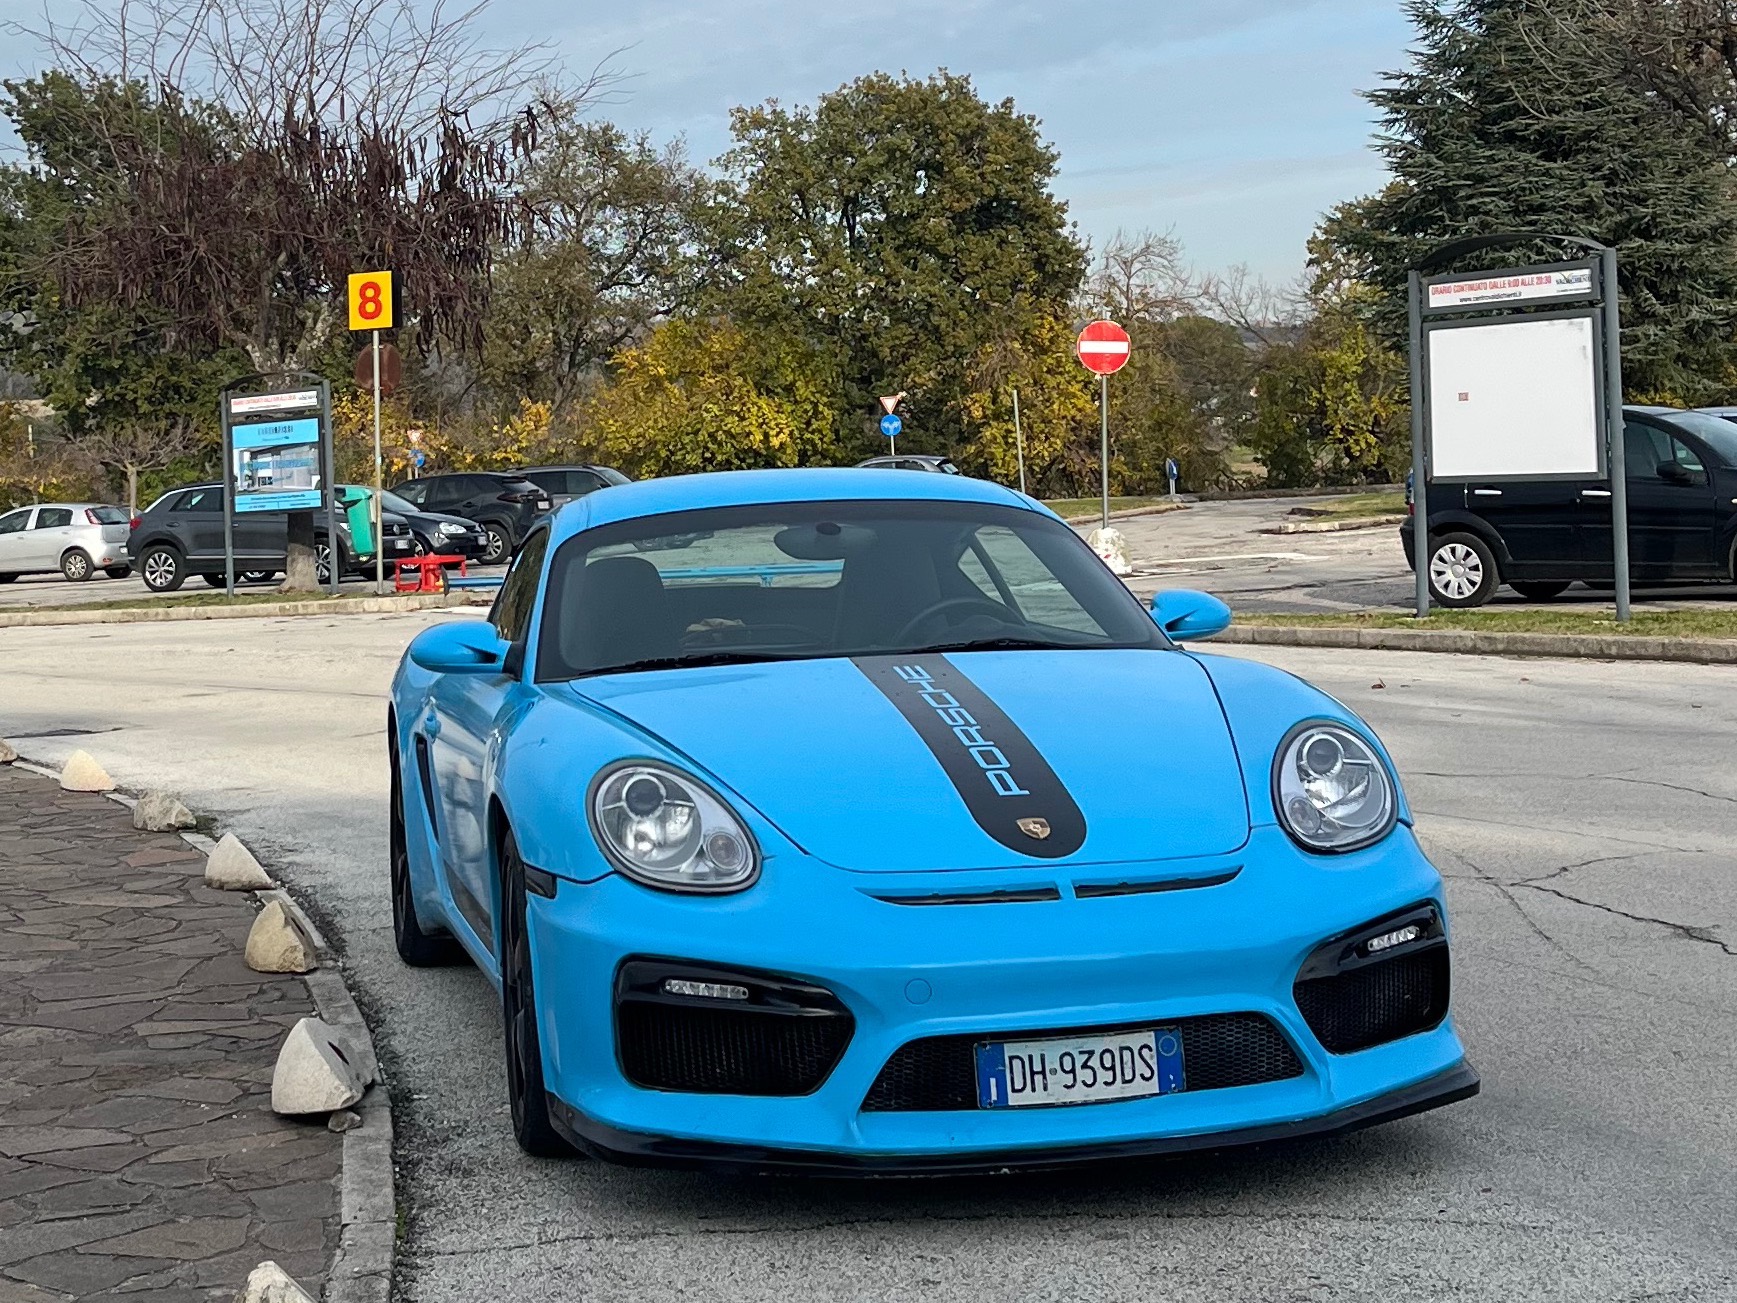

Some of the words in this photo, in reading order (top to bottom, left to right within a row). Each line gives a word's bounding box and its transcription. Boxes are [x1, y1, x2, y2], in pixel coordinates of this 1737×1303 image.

[359, 281, 382, 320] 8
[1431, 285, 1451, 296] ORARIO
[1453, 282, 1487, 294] CONTINUATO
[1488, 280, 1507, 290] DALLE
[1520, 277, 1535, 287] ALLE
[893, 665, 1030, 796] PORSCHE
